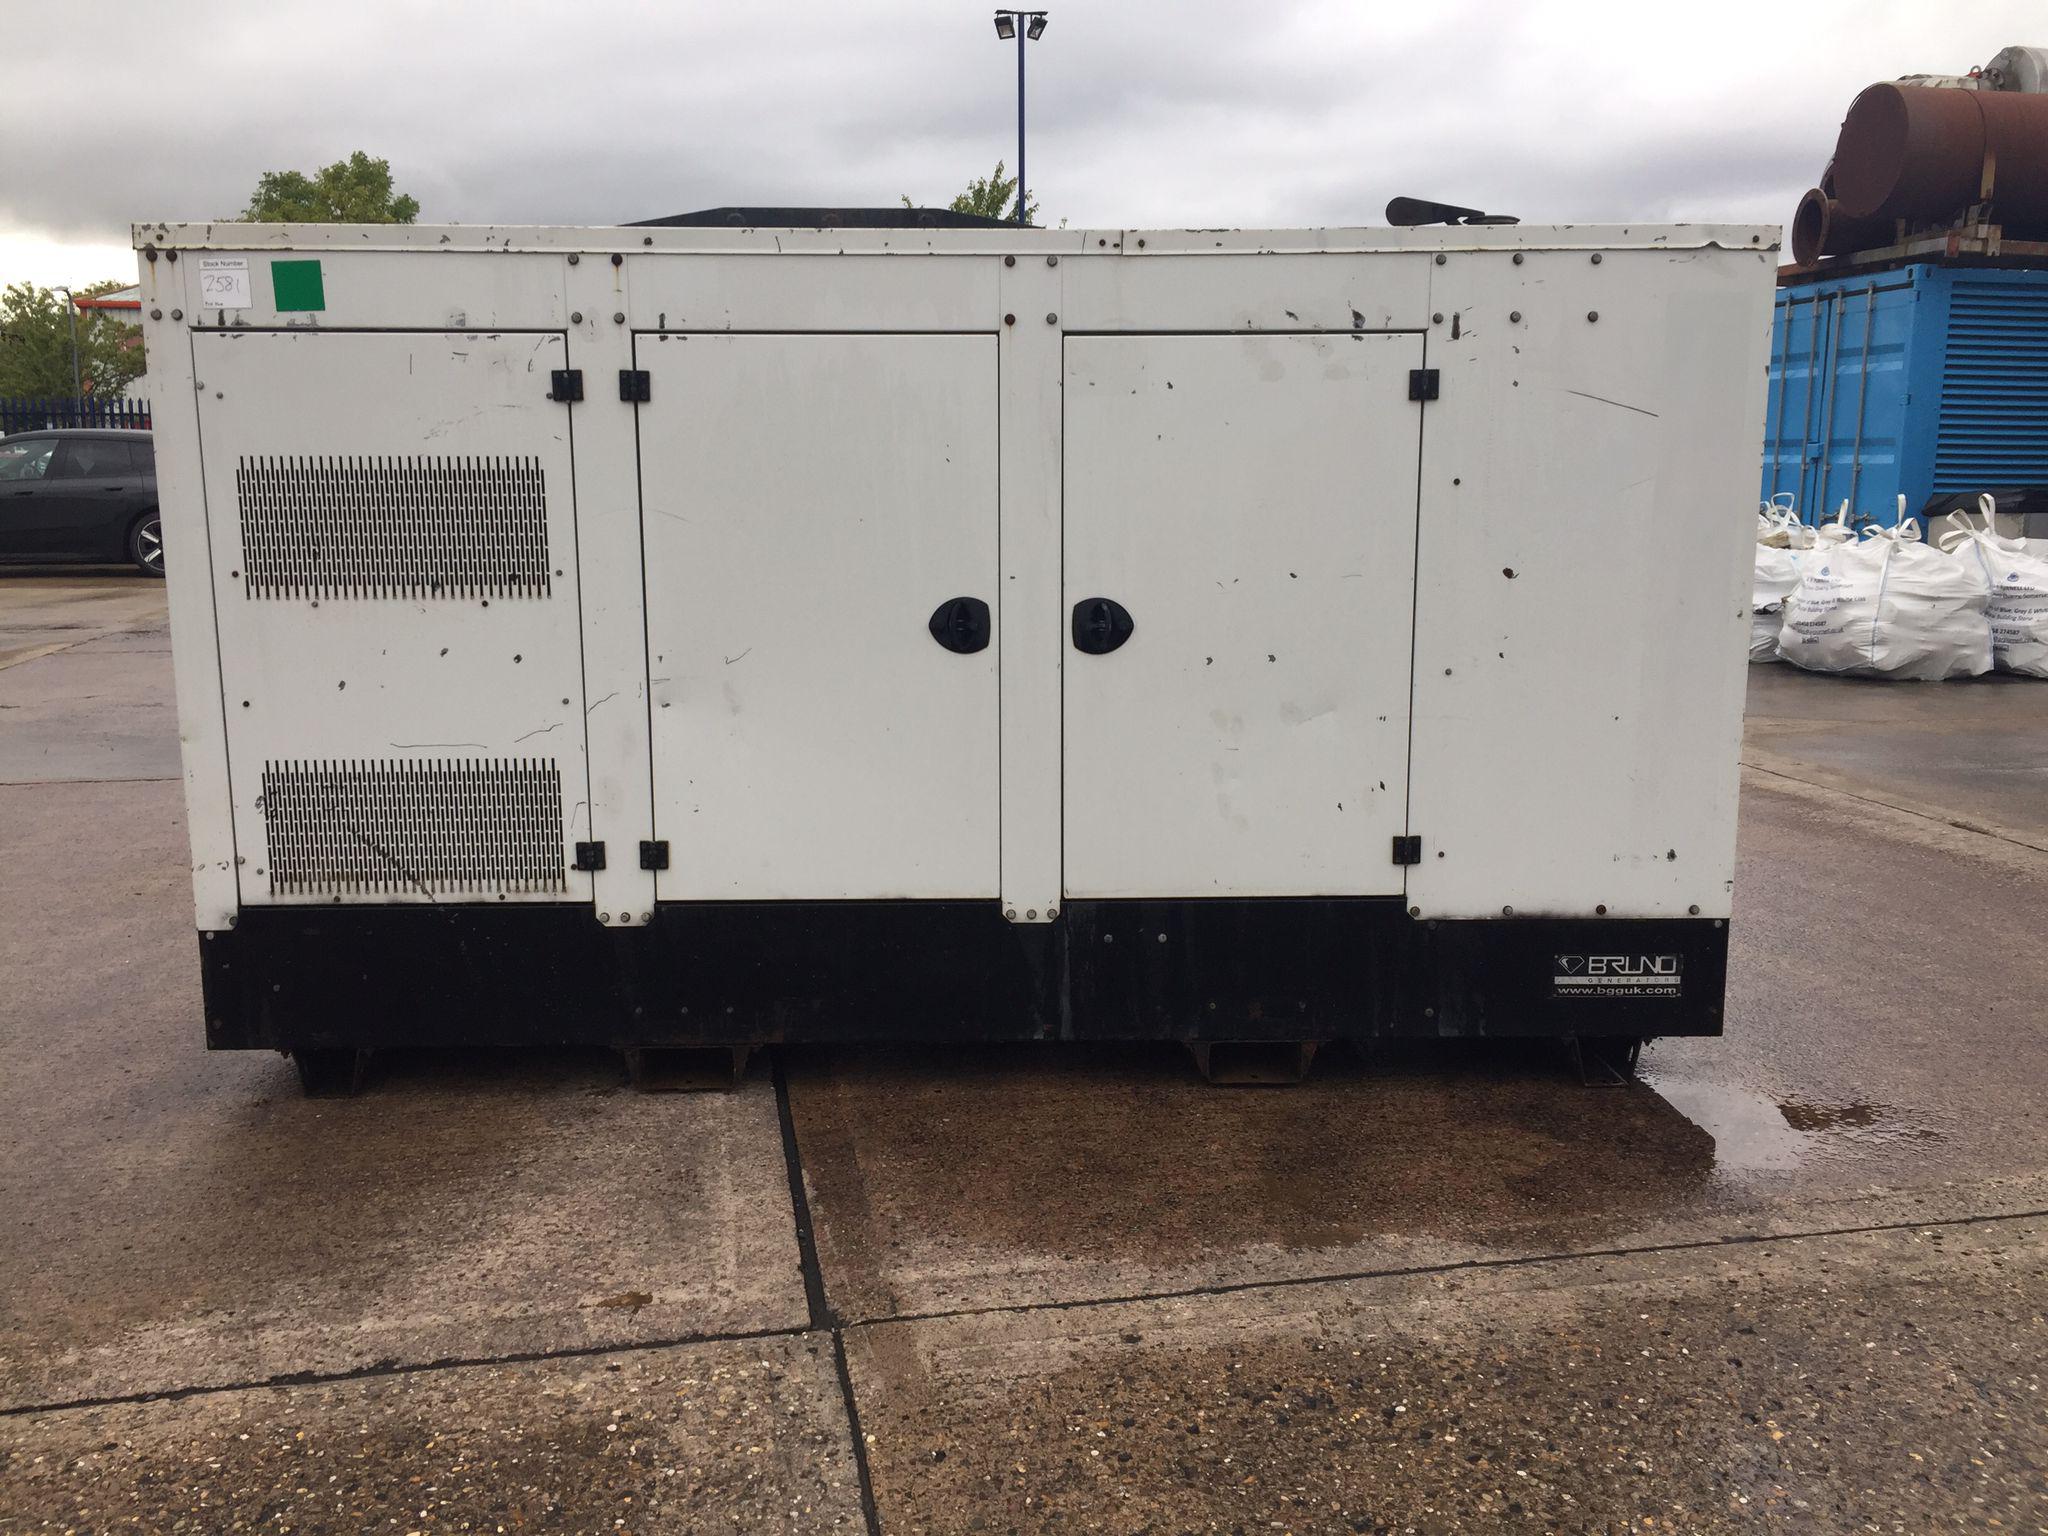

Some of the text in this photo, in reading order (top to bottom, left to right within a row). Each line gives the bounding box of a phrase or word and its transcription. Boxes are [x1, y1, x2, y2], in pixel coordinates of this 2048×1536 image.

[203, 275, 240, 294] 2581
[1588, 956, 1677, 974] BRUNO
[1558, 986, 1677, 996] www.bgguk.com
